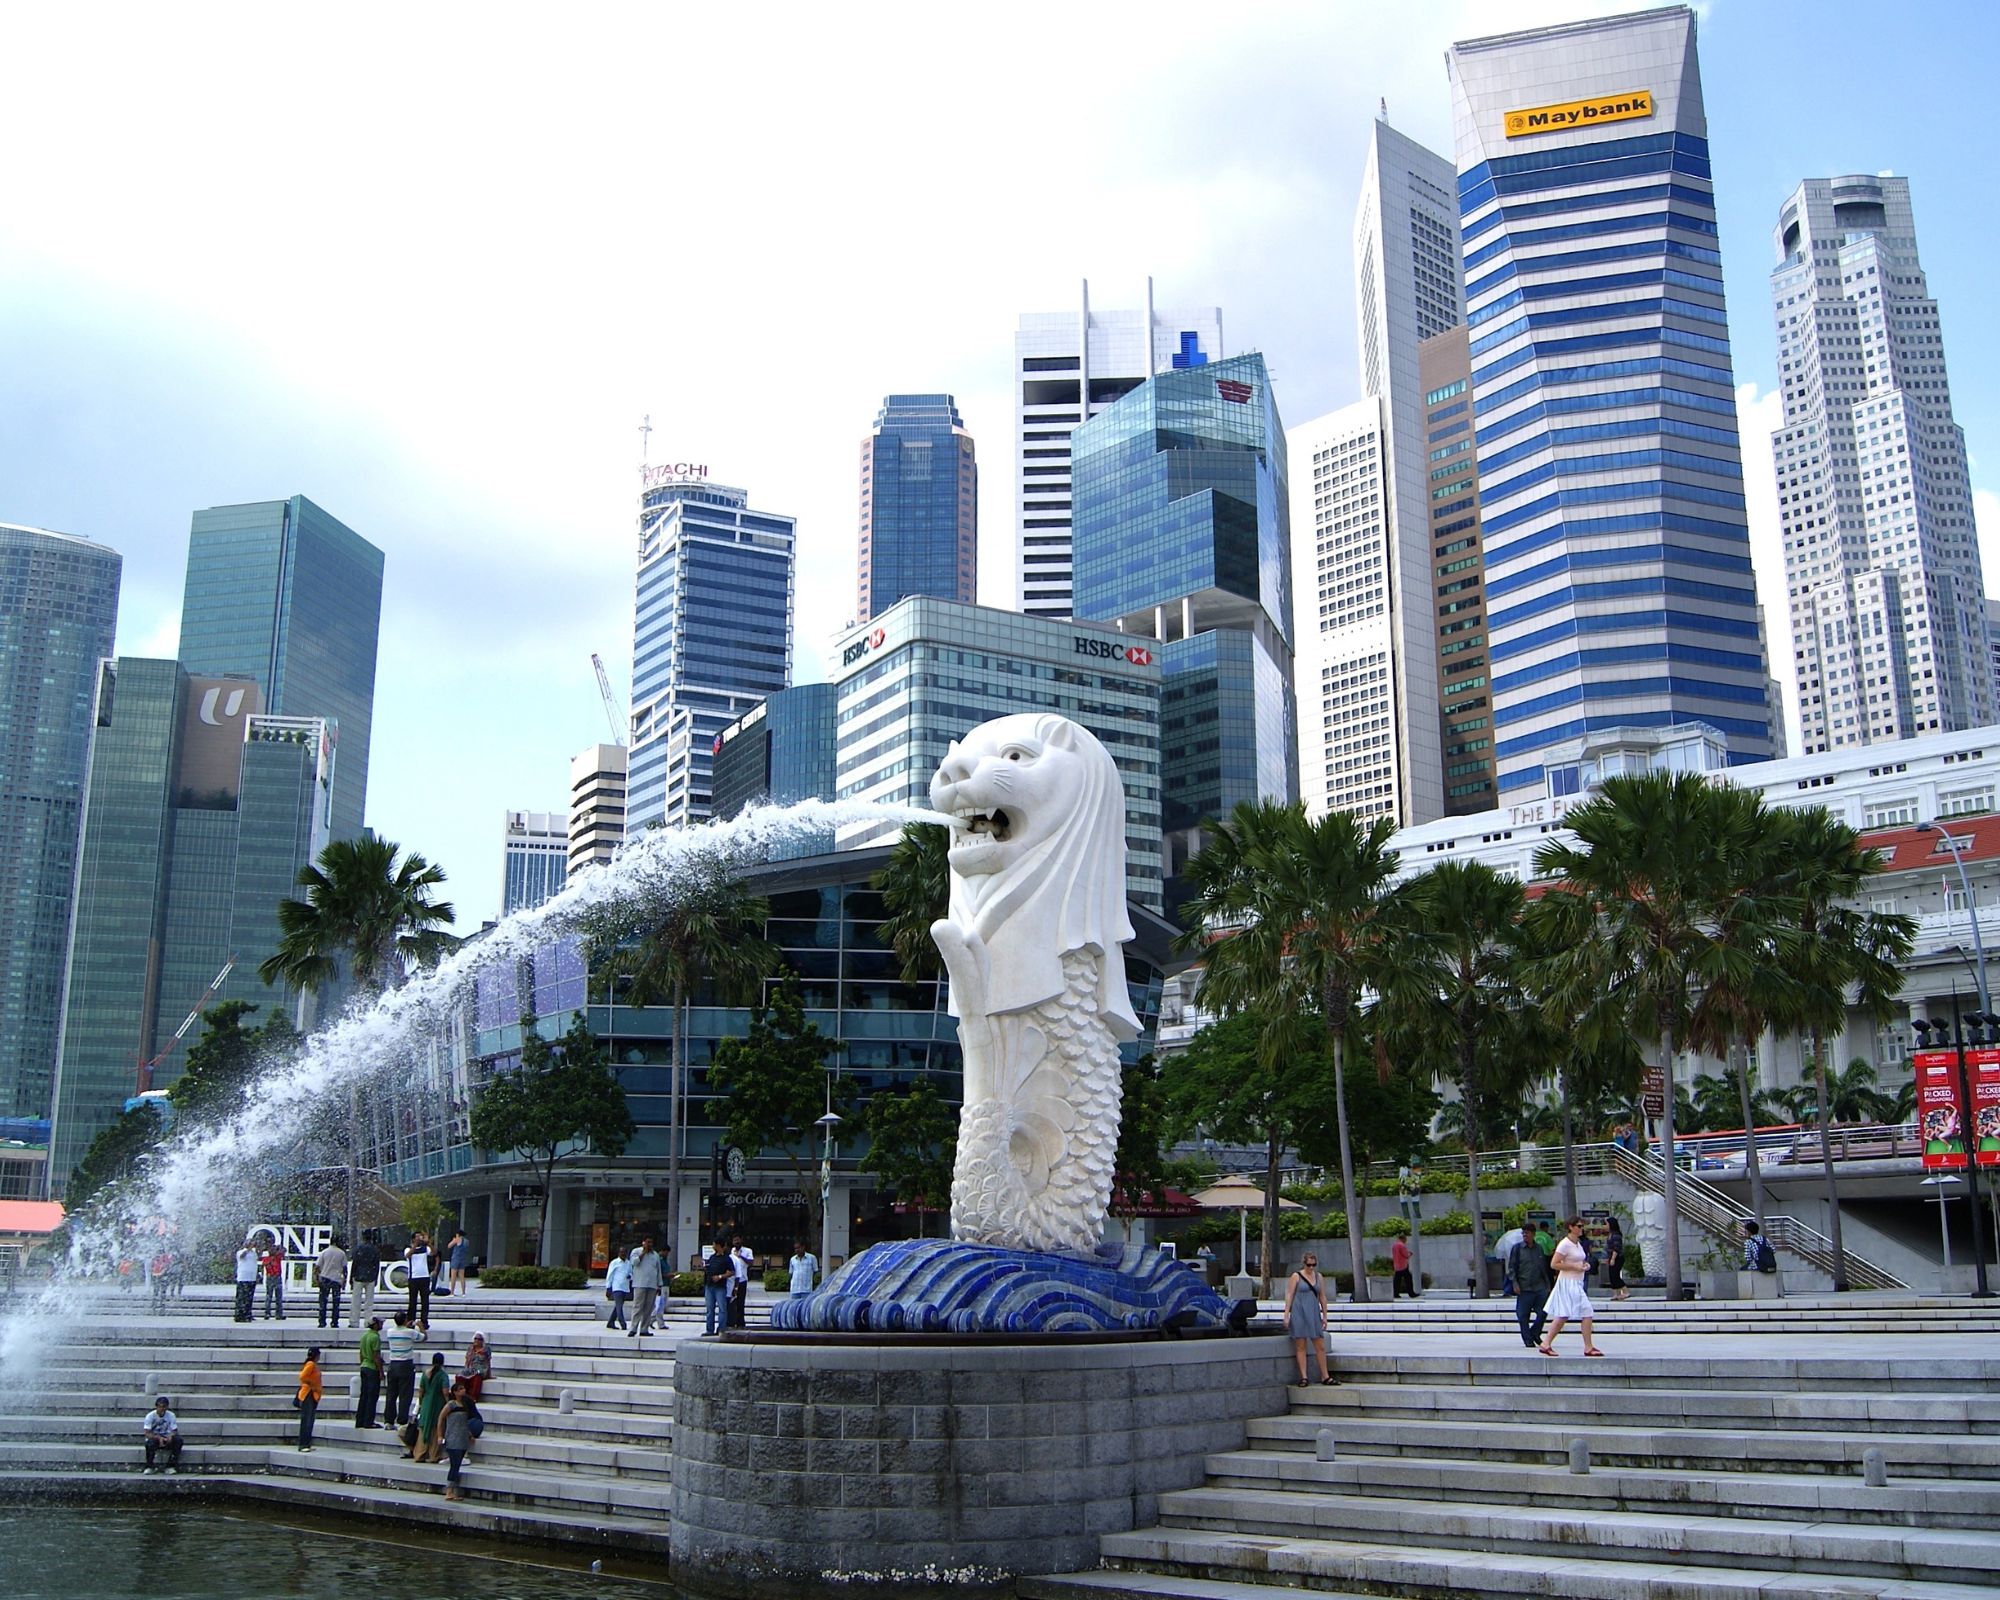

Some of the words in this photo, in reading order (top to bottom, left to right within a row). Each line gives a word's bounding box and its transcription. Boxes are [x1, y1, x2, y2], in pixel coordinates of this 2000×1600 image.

[1528, 98, 1647, 127] Maybank
[843, 636, 870, 667] HSBC
[1074, 636, 1124, 661] HSBC
[1508, 806, 1544, 825] THE
[745, 1192, 787, 1206] Coffee
[247, 1224, 333, 1257] ONE
